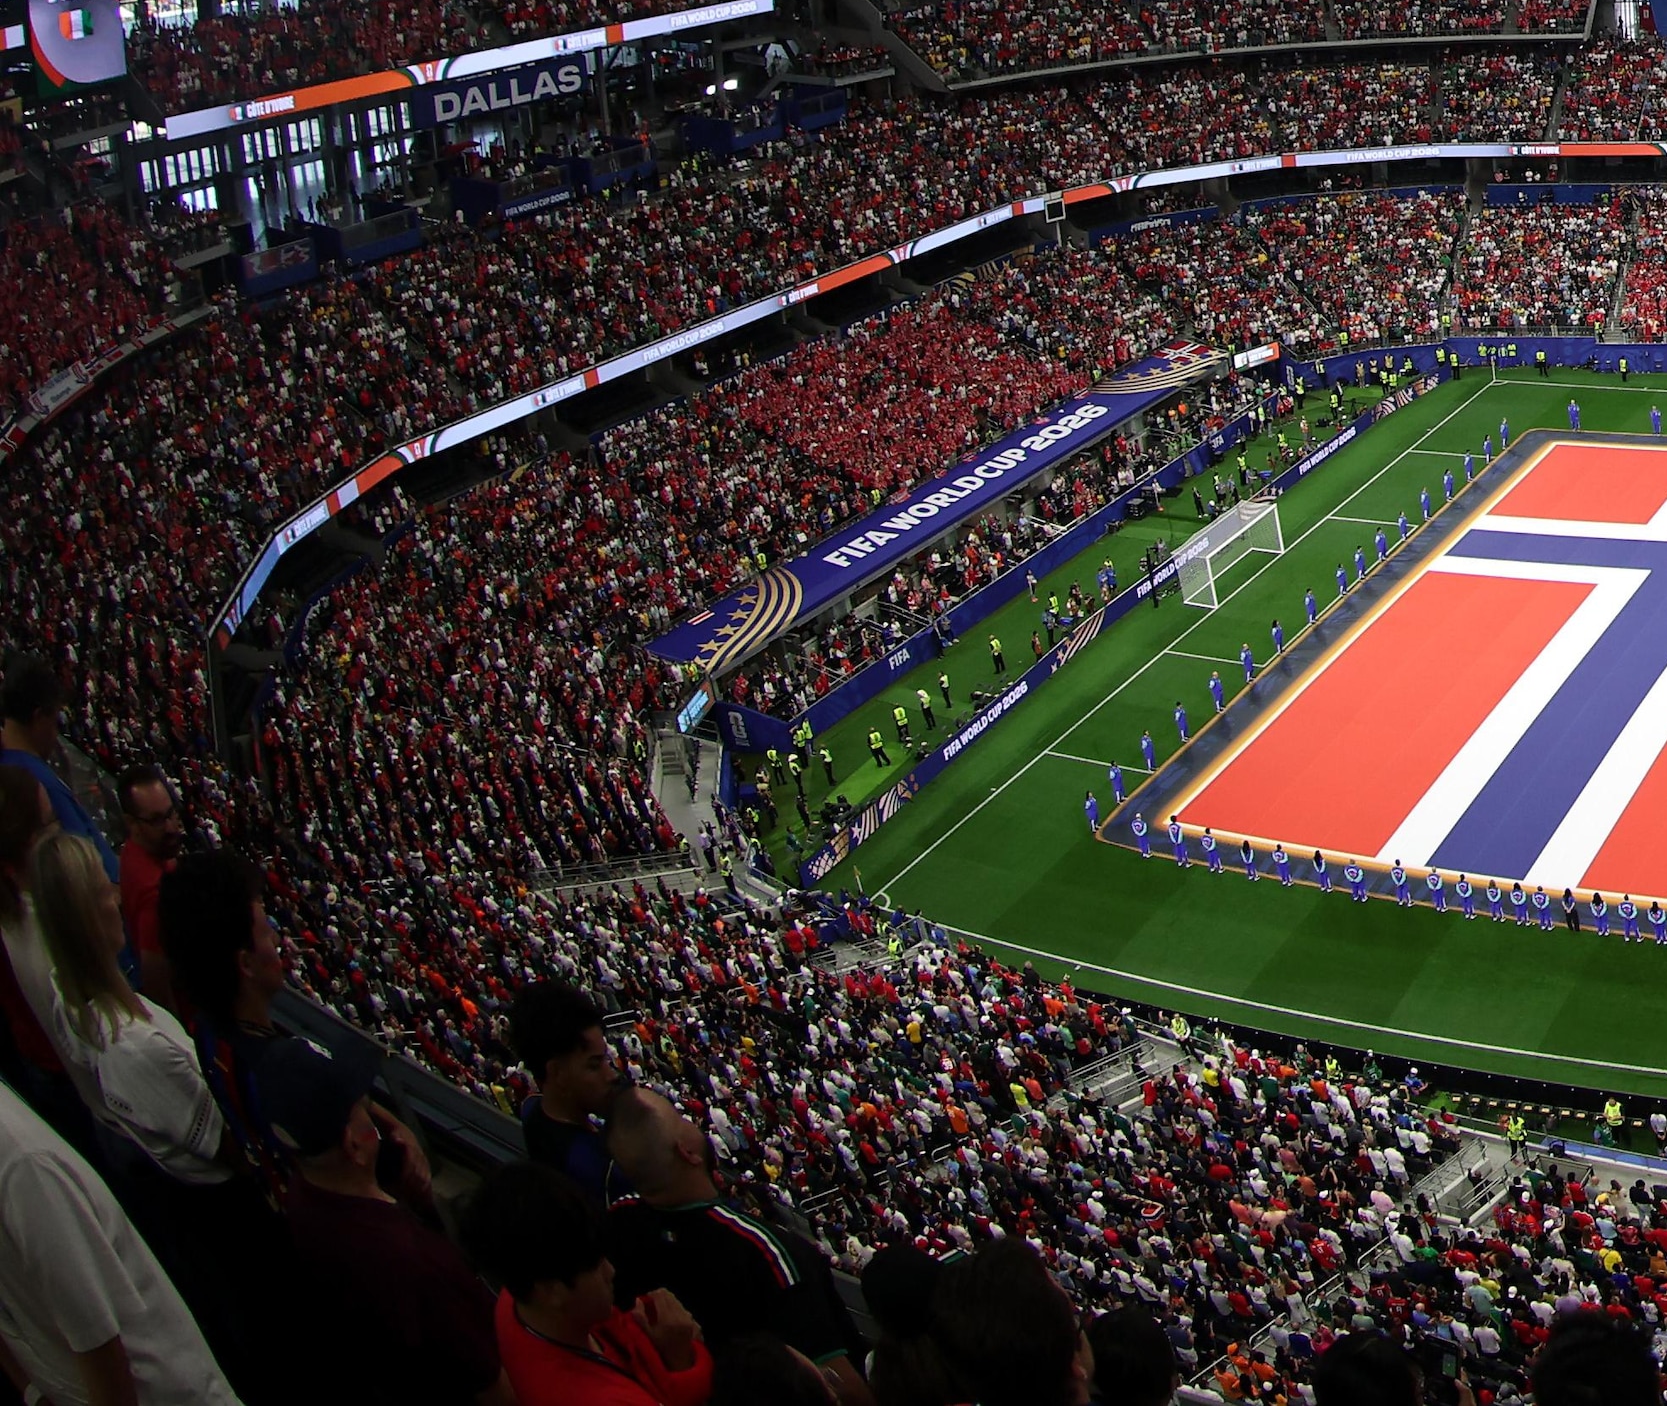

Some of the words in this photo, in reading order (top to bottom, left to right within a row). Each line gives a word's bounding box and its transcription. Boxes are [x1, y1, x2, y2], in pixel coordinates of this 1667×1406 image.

[671, 15, 688, 28] FIFA
[690, 10, 715, 25] WORLD
[716, 6, 731, 20] CUP
[731, 1, 757, 17] 2026
[247, 101, 264, 118] CÔTE
[266, 95, 295, 115] D'IVOIRE
[434, 64, 583, 123] DALLAS
[1347, 152, 1365, 161] FIFA
[1366, 151, 1391, 160] WORLD
[1393, 150, 1410, 158] CUP
[1411, 147, 1440, 157] 2026
[1521, 144, 1534, 155] CÔTE
[1535, 145, 1560, 154] D'IVOIRE
[505, 207, 518, 218] FIFA
[518, 201, 538, 214] WORLD
[539, 196, 550, 208] CUP
[550, 191, 570, 204] 2026
[643, 345, 658, 361] FIFA
[660, 337, 684, 355] WORLD
[685, 332, 699, 348] CUP
[700, 322, 724, 342] 2026
[1298, 460, 1312, 476] FIFA
[1311, 447, 1329, 468] WORLD
[1328, 439, 1338, 453] CUP
[1339, 426, 1356, 446] 2026
[822, 530, 900, 568] FIFA
[881, 475, 985, 531] WORLD
[974, 447, 1028, 479] CUP
[1020, 403, 1109, 452] 2026
[1136, 580, 1153, 598] FIFA
[1174, 553, 1187, 571] CUP
[1186, 537, 1209, 562] 2026
[888, 648, 910, 670] FIFA
[943, 741, 960, 761] FIFA
[960, 717, 988, 746] WORLD
[987, 703, 1002, 724] CUP
[1002, 681, 1029, 711] 2026
